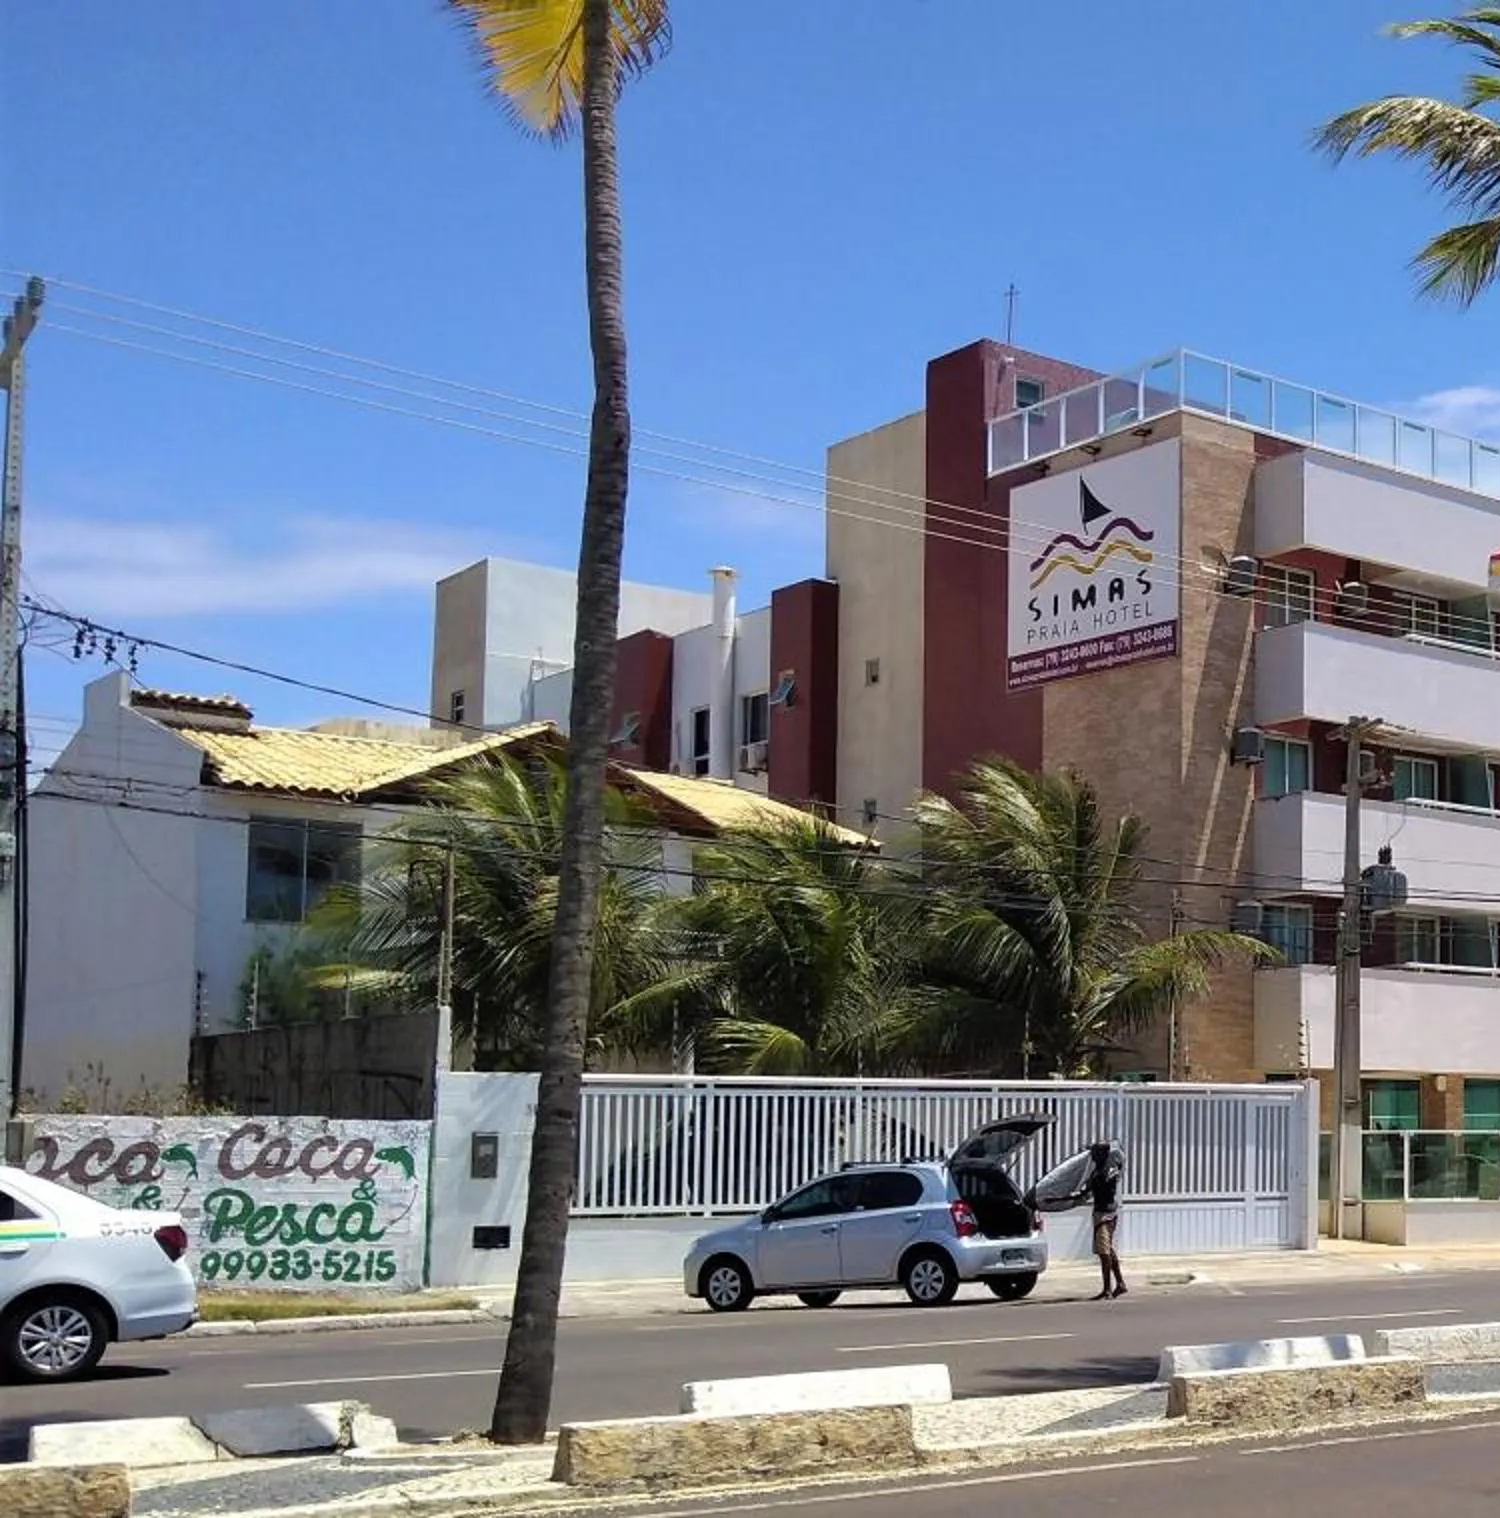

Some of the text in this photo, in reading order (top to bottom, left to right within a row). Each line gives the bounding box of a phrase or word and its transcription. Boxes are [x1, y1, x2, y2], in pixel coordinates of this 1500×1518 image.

[1028, 569, 1152, 622] SIMAS
[1027, 601, 1153, 645] PRAIA HOTEL
[351, 1177, 379, 1206] &
[203, 1187, 386, 1246] Pesca
